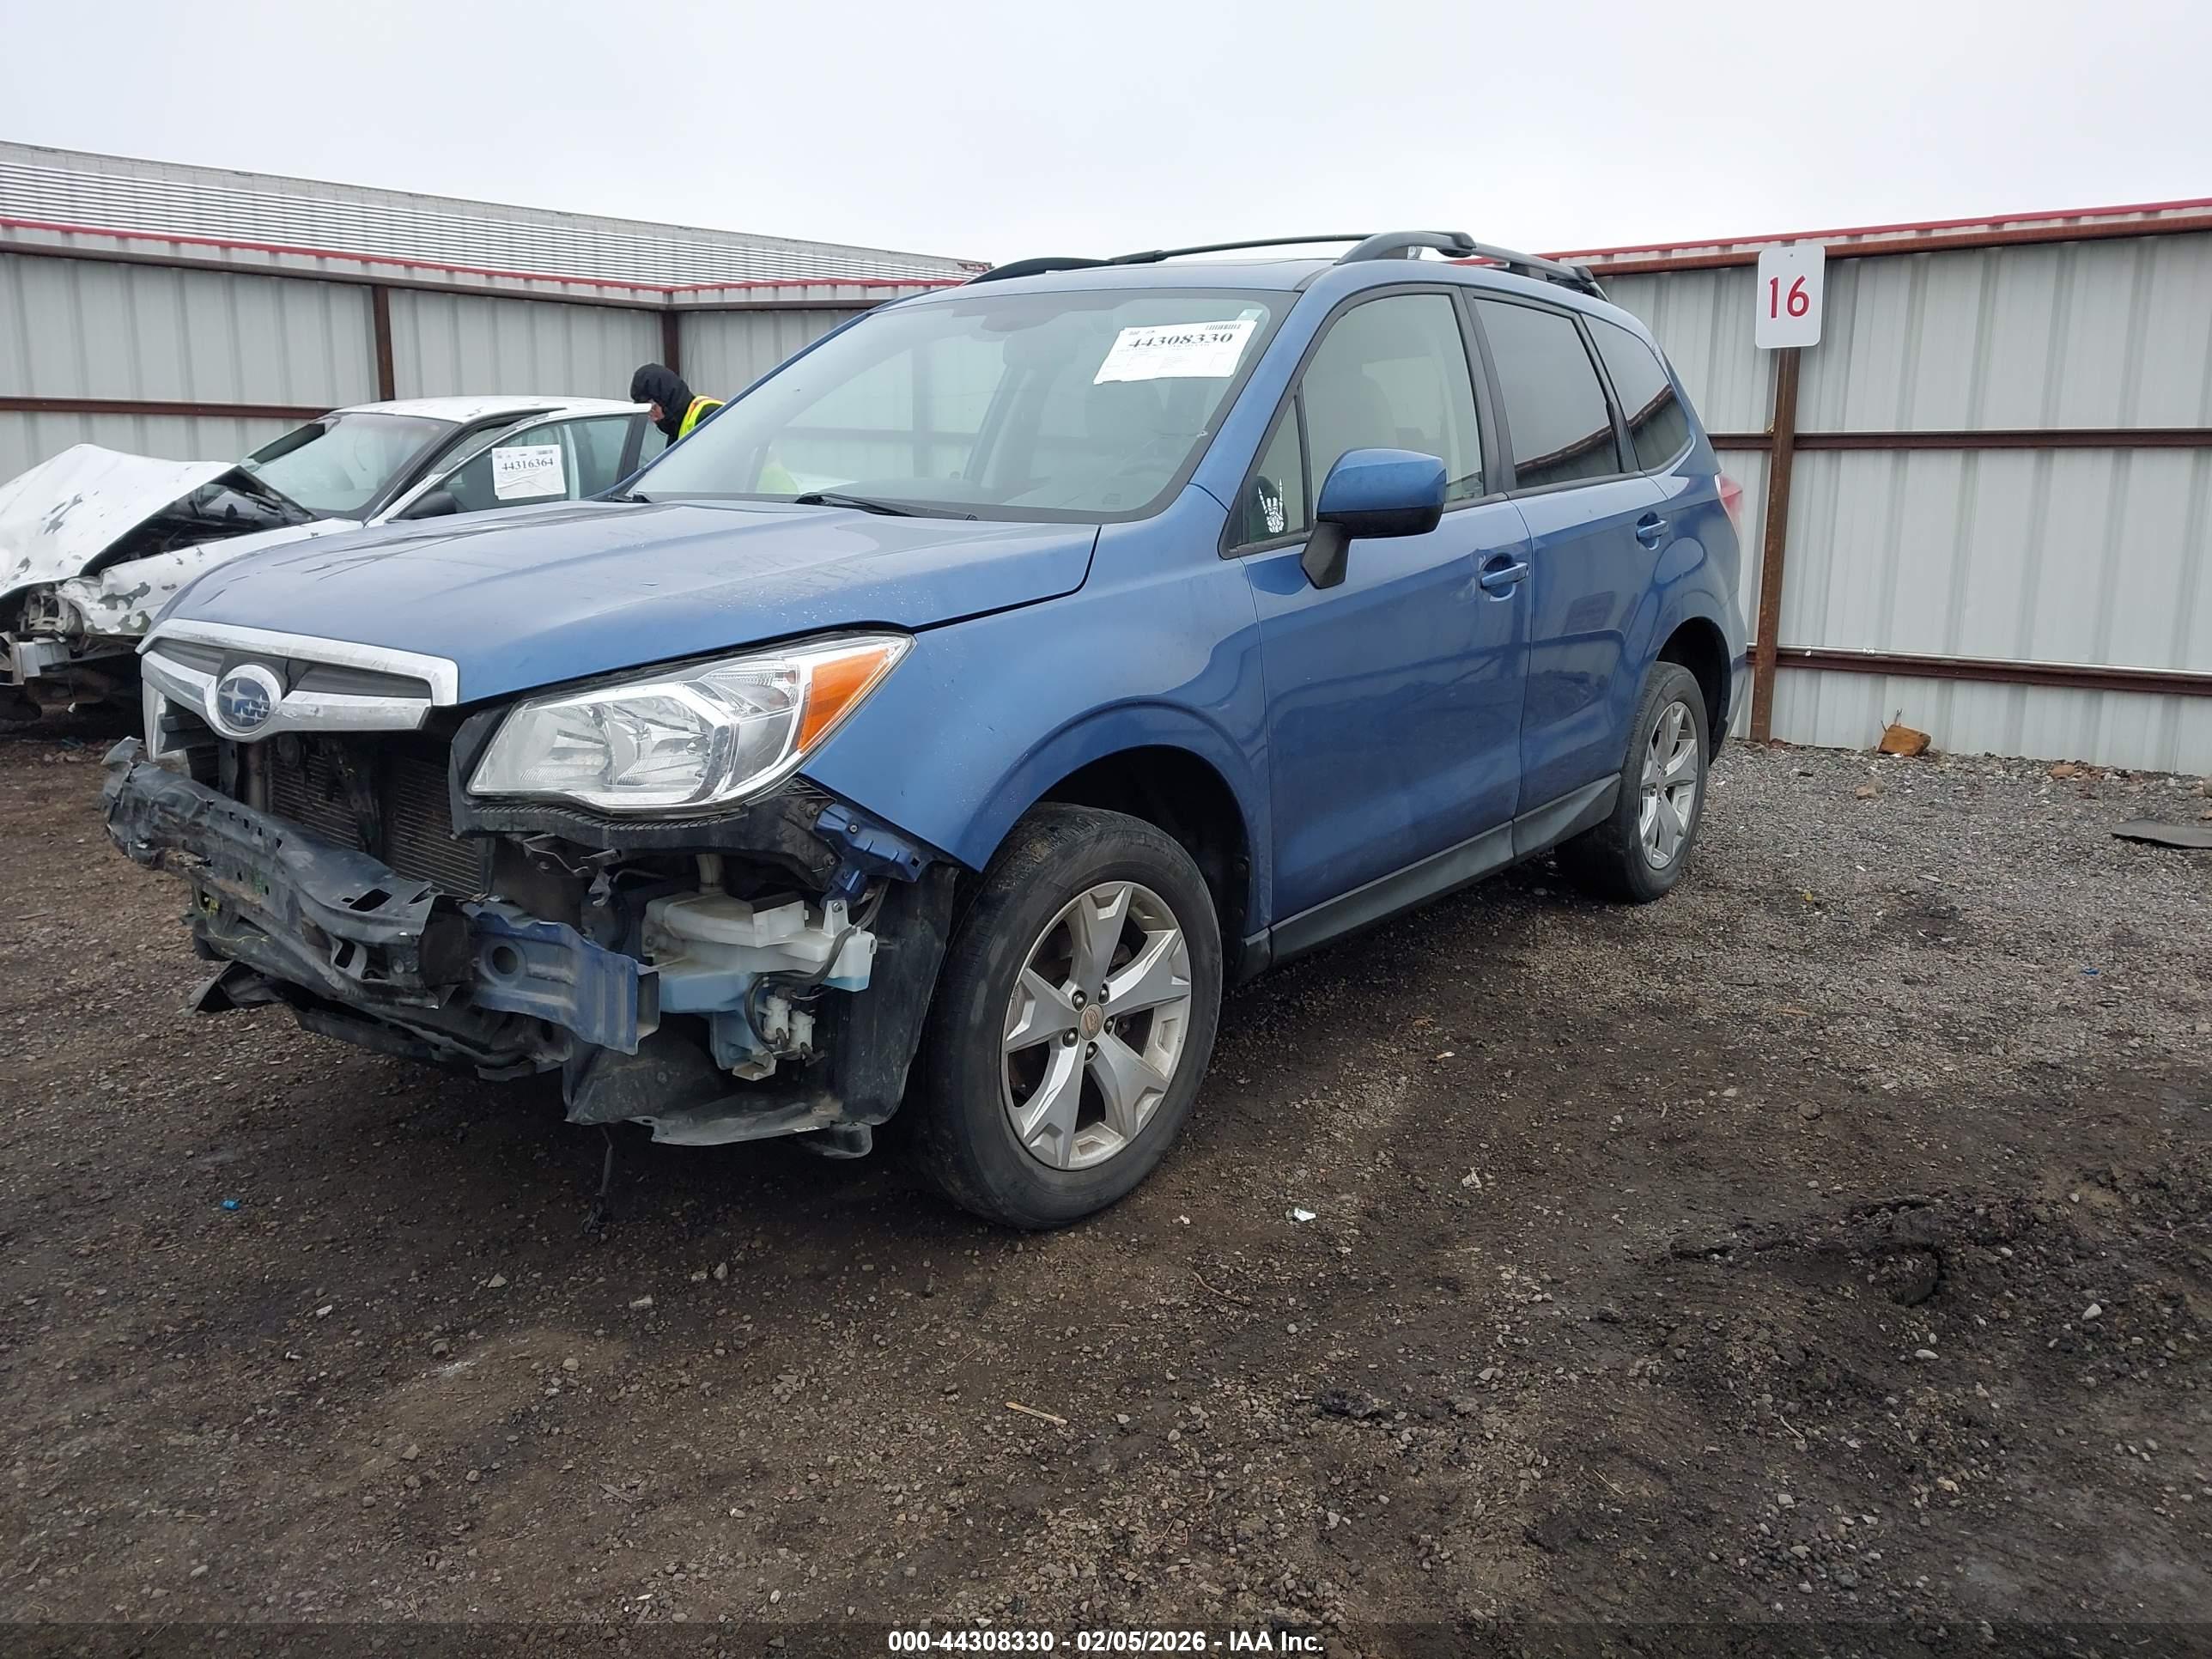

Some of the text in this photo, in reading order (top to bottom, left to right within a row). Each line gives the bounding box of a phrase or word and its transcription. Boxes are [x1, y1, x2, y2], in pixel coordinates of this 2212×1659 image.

[1769, 275, 1810, 319] 16
[1128, 333, 1233, 348] 44308330
[501, 457, 554, 471] 44316364
